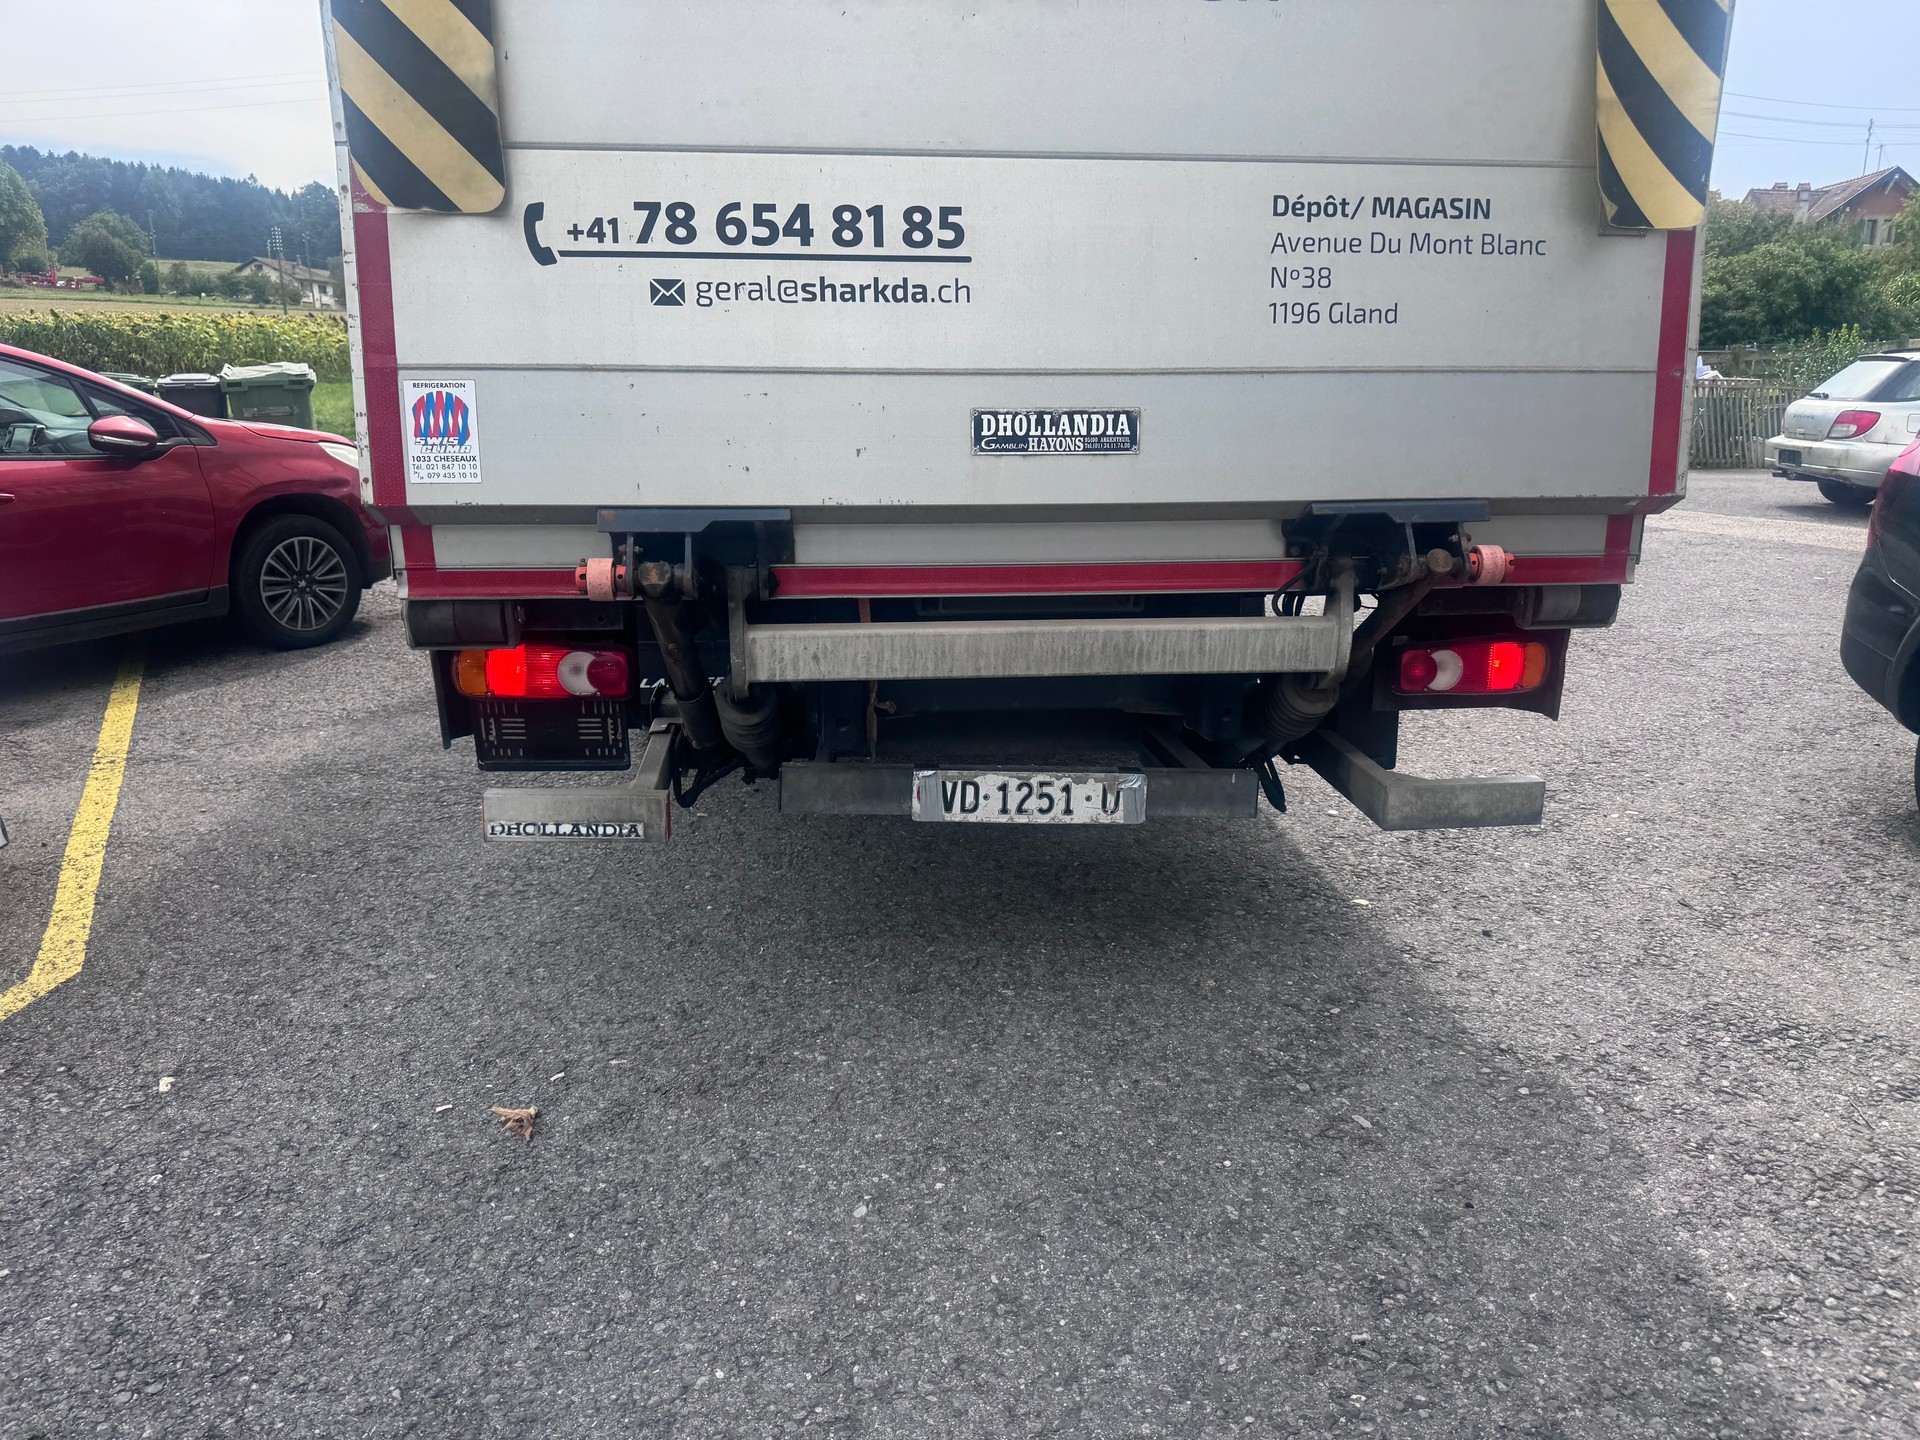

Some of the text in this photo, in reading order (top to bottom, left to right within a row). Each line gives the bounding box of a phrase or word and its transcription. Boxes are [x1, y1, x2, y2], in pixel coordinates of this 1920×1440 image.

[1272, 194, 1491, 223] Dépôt/ MAGASIN
[566, 201, 965, 249] +41 78 654 81 85
[1271, 232, 1547, 256] Avenue Du Mont Blanc
[696, 274, 970, 308] geral@sharkda.ch
[1268, 302, 1398, 324] 1196 Gland
[981, 414, 1131, 436] DHOLLANDIA
[1028, 437, 1084, 451] HAYONS
[489, 822, 641, 837] DHOLLANDIA
